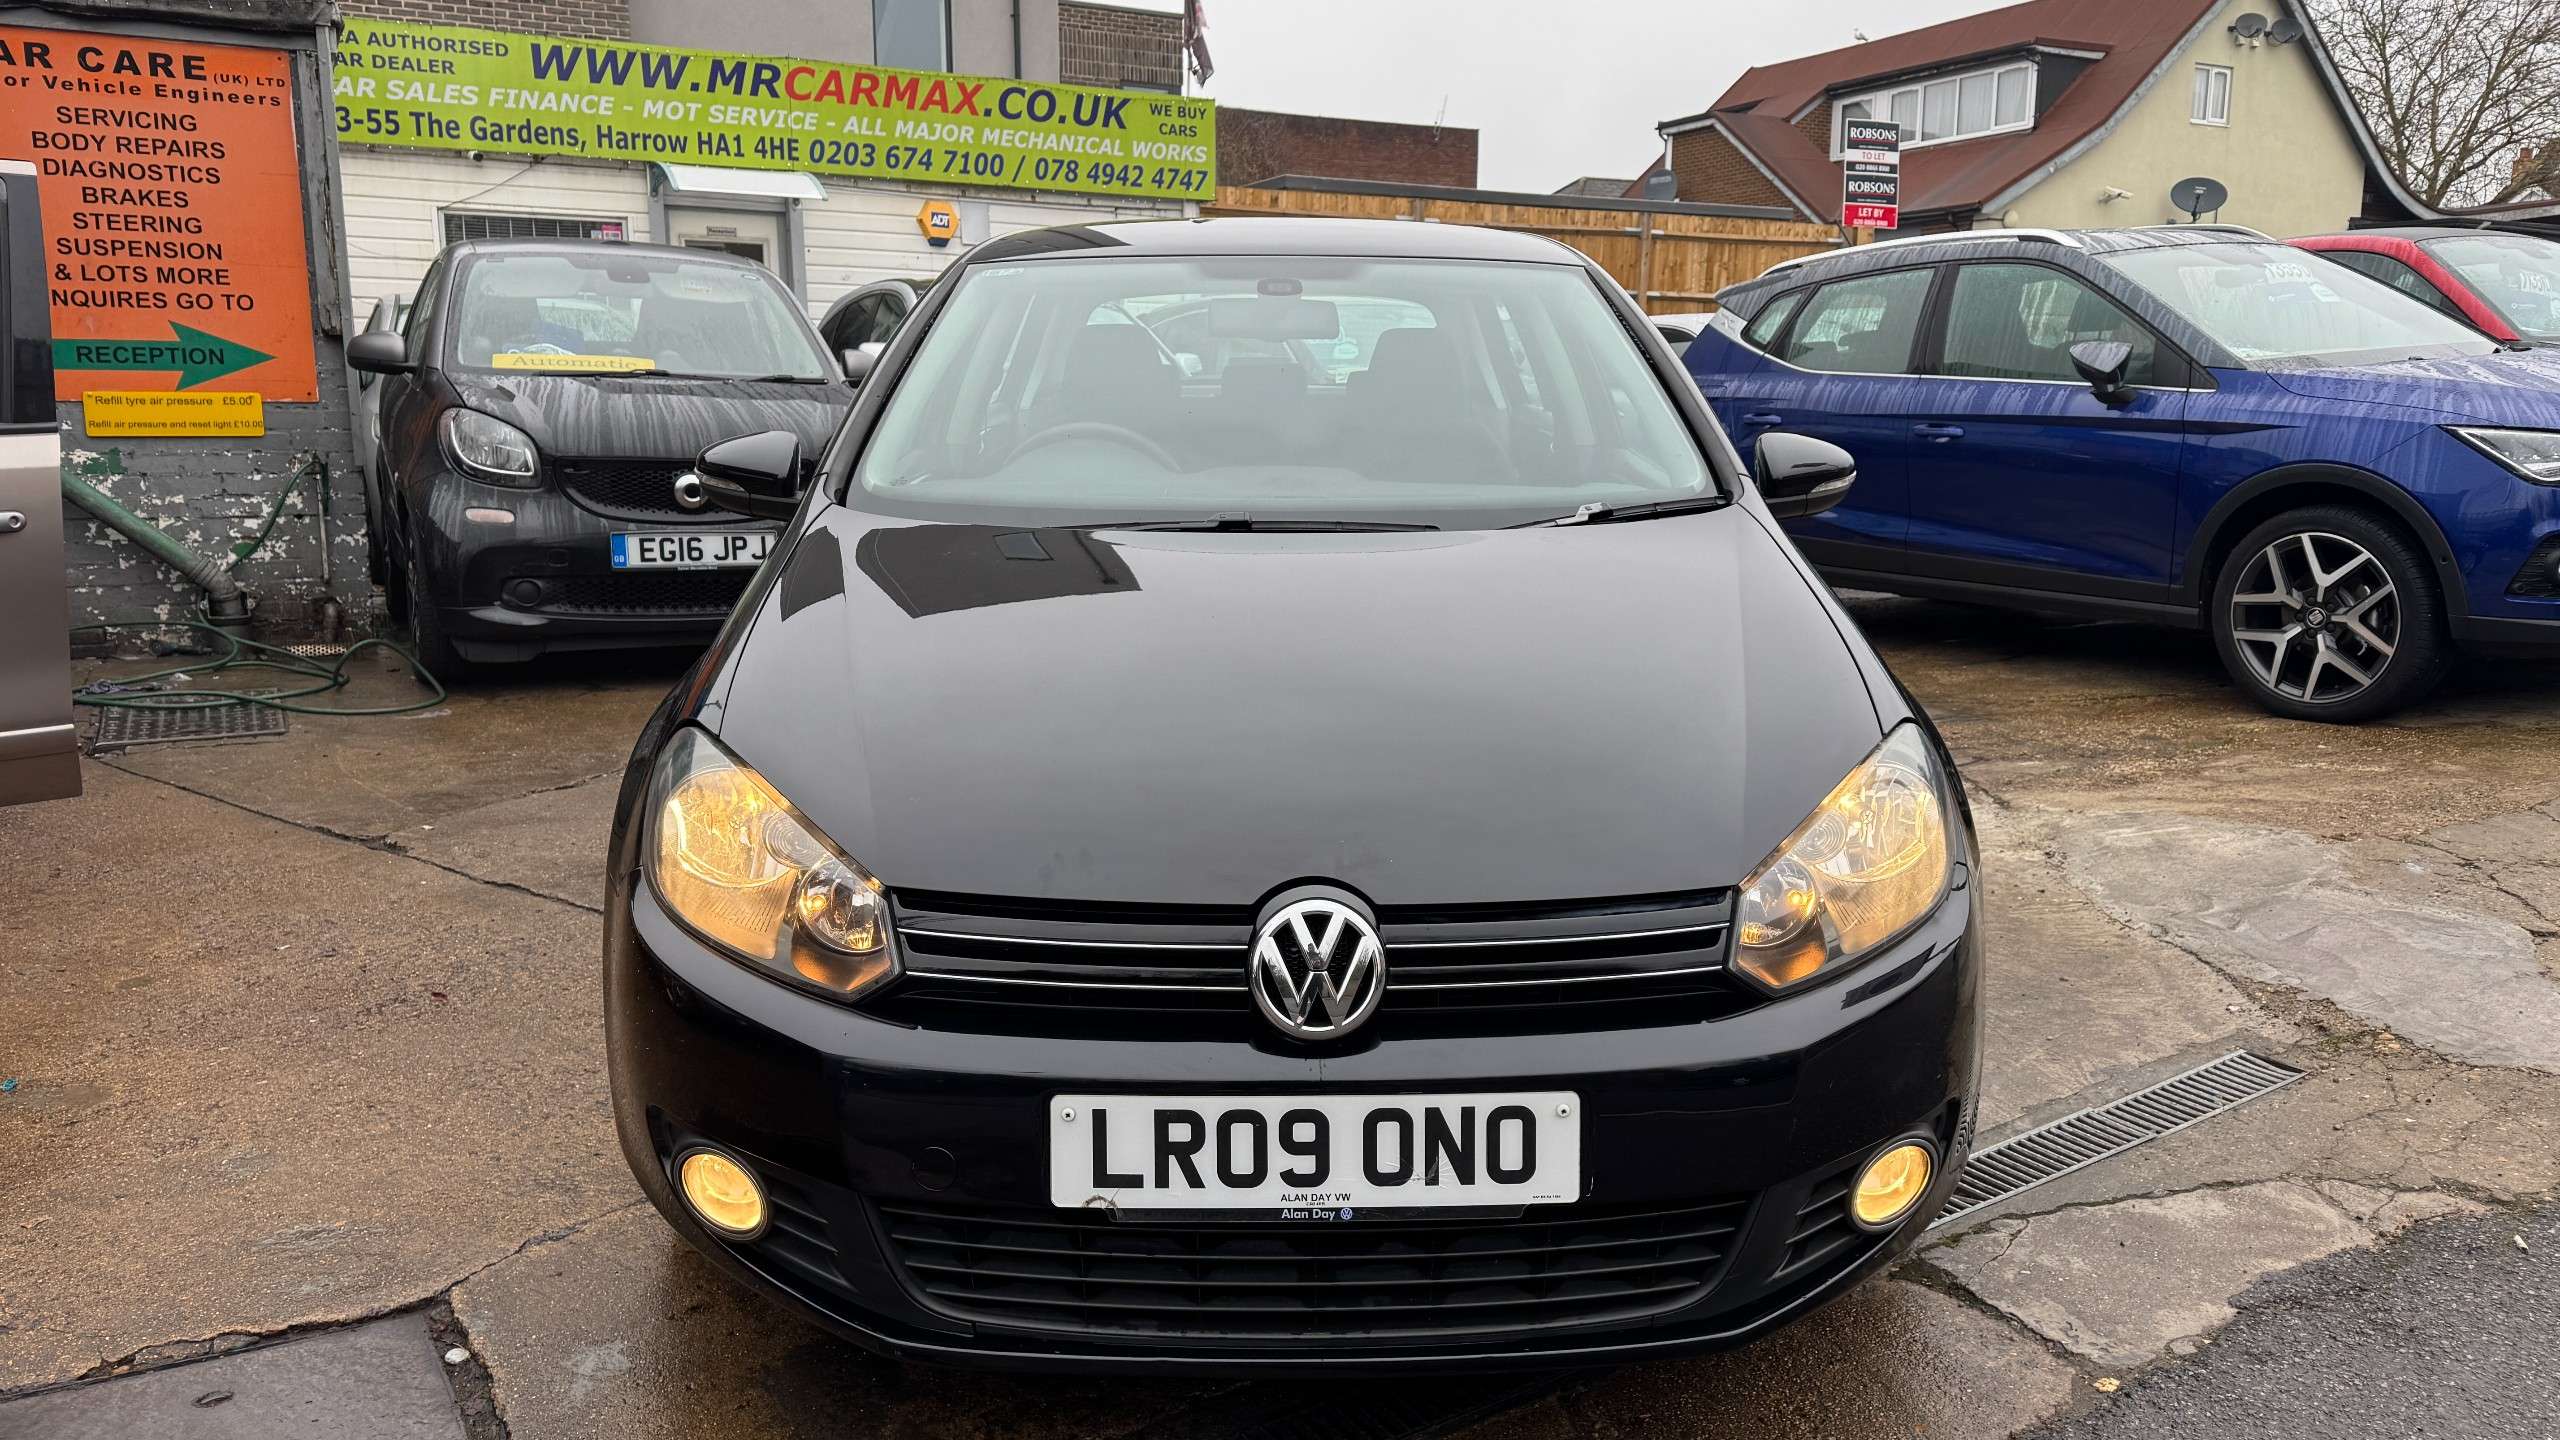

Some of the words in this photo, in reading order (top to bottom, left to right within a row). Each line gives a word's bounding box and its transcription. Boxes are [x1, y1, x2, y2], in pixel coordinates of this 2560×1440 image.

[367, 32, 509, 57] AUTHORISED
[77, 46, 207, 81] CARE
[213, 73, 249, 87] (UK)
[256, 76, 286, 88] LTD
[372, 54, 456, 75] DEALER
[42, 75, 142, 95] Vehicle
[154, 84, 281, 107] Engineers
[530, 43, 1131, 130] WWW.MRCARMAX.CO.UK
[56, 106, 198, 132] SERVICING
[335, 76, 376, 98] AR
[386, 79, 479, 106] SALES
[488, 87, 614, 115] FINANCE
[643, 100, 702, 121] MOT
[708, 104, 818, 130] SERVICE
[843, 116, 887, 137] ALL
[895, 120, 974, 144] MAJOR
[982, 127, 1124, 157] MECHANICAL
[1132, 140, 1208, 163] WORKS
[1150, 103, 1172, 117] WE
[1177, 106, 1207, 120] BUY
[1159, 123, 1197, 137] CARS
[1850, 127, 1897, 141] ROBSONS
[31, 131, 107, 152] BODY
[116, 136, 226, 159] REPAIRS
[409, 111, 460, 139] The
[470, 116, 587, 152] Gardens,
[597, 125, 687, 154] Harrow
[697, 131, 744, 157] HA1
[754, 136, 800, 161] 4HE
[809, 139, 875, 167] 0203
[885, 144, 933, 171] 674
[943, 150, 1004, 176] 7100
[1012, 155, 1026, 182] /
[1035, 157, 1078, 182] 078
[1086, 162, 1144, 188] 4942
[1151, 167, 1208, 192] 4747
[1862, 152, 1872, 160] TO
[1874, 152, 1886, 160] LET
[42, 158, 221, 184] DIAGNOSTICS
[82, 187, 189, 208] BRAKES
[1848, 181, 1895, 194] ROBSONS
[72, 212, 203, 234] STEERING
[931, 213, 949, 226] ADT
[1858, 208, 1873, 217] LET
[1873, 208, 1885, 218] BY
[56, 238, 222, 261] SUSPENSION
[54, 263, 72, 281] &
[80, 265, 148, 283] LOTS
[157, 267, 231, 285] MORE
[51, 290, 167, 309] NQUIRES
[176, 293, 213, 310] GO
[221, 294, 254, 311] TO
[76, 346, 225, 365] RECEPTION
[512, 355, 637, 370] Automatic
[95, 395, 122, 405] Refill
[126, 397, 147, 407] tyre
[150, 396, 163, 405] air
[166, 397, 213, 407] pressure
[222, 396, 252, 406] £5.00
[89, 420, 111, 429] Refill
[114, 420, 125, 428] air
[128, 421, 168, 430] pressure
[213, 420, 231, 429] light
[614, 555, 625, 563] GB
[638, 537, 704, 563] EG16
[713, 536, 768, 561] JPJ
[1091, 1108, 1331, 1190] LR09
[1362, 1105, 1537, 1187] ONO
[1281, 1193, 1308, 1202] ALAN
[1311, 1193, 1332, 1202] DAY
[1335, 1193, 1351, 1201] VW
[1281, 1208, 1309, 1219] Alan
[1312, 1208, 1335, 1221] Day
